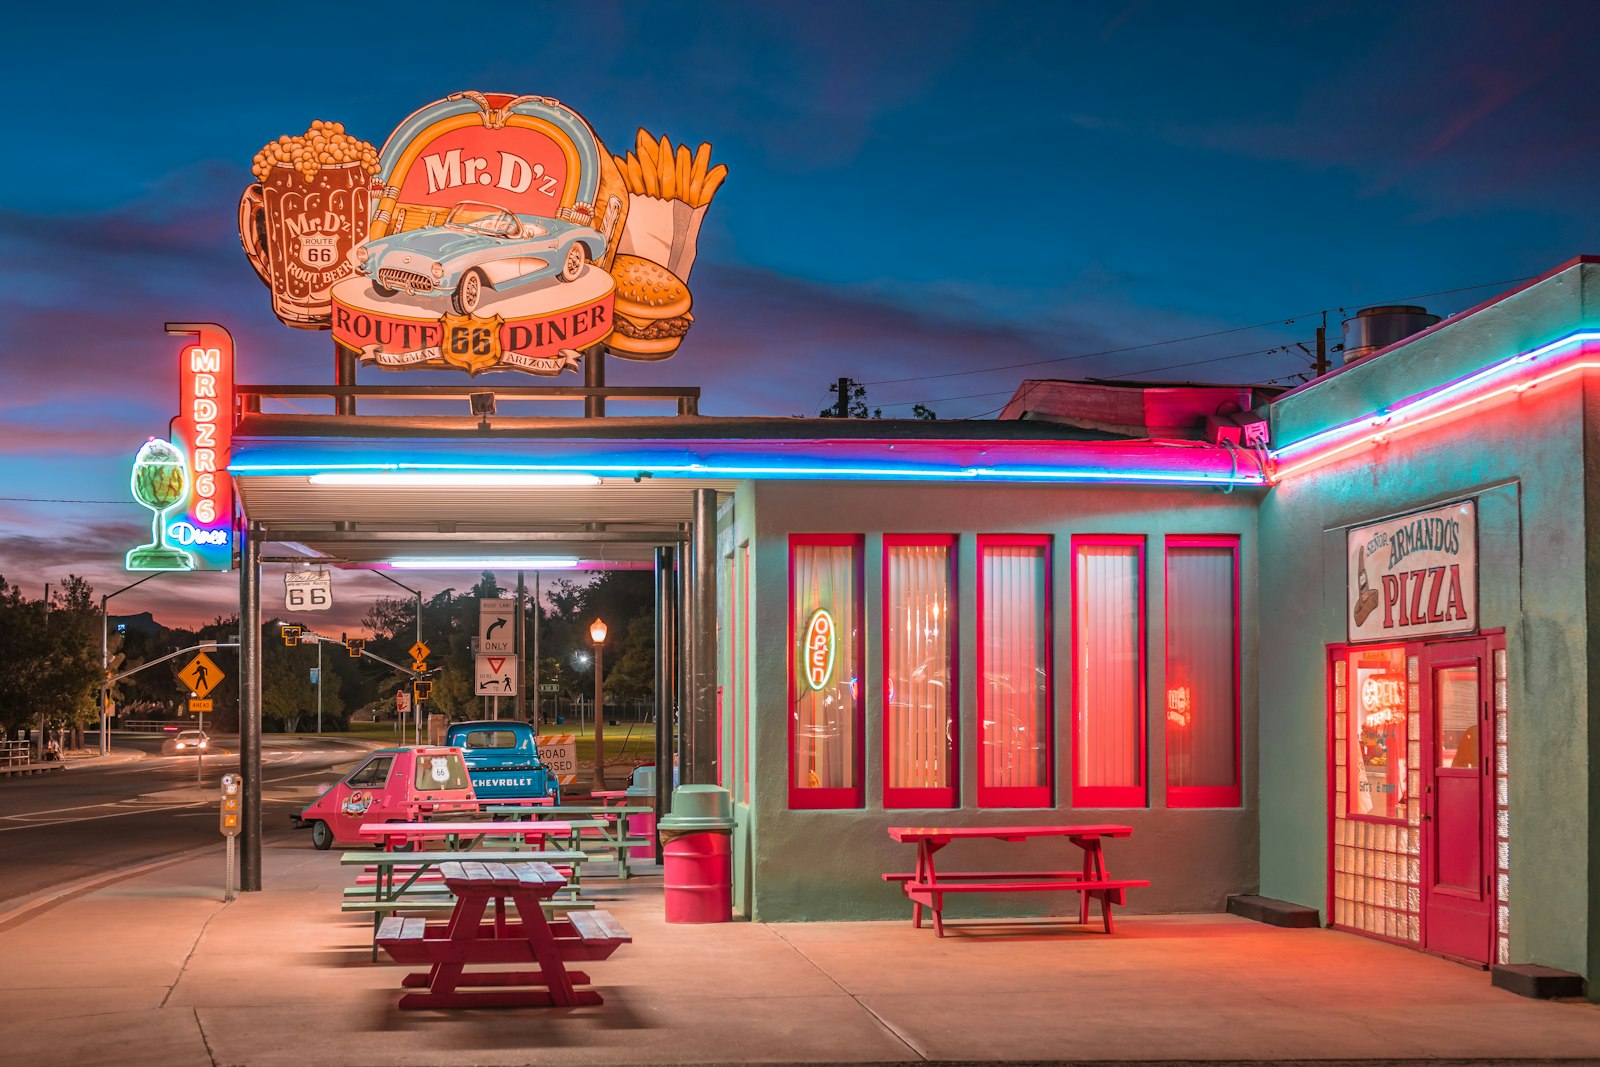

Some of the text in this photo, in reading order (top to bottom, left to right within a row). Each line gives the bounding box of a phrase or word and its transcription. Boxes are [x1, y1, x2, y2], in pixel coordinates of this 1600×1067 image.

[421, 148, 492, 195] Mr.
[285, 212, 322, 238] Mr.
[308, 248, 331, 262] 66
[287, 260, 353, 284] ROOT BEER
[337, 305, 606, 355] ROUTE 66 DINER
[379, 348, 561, 369] KINGMAN ARIZONA
[168, 521, 228, 546] Diner
[289, 588, 326, 605] 66
[1381, 564, 1467, 628] PIZZA
[485, 642, 508, 651] ONLY
[539, 749, 566, 758] ROAD
[436, 768, 445, 777] 66
[547, 761, 572, 771] OSED
[472, 778, 532, 787] CHEVROLET
